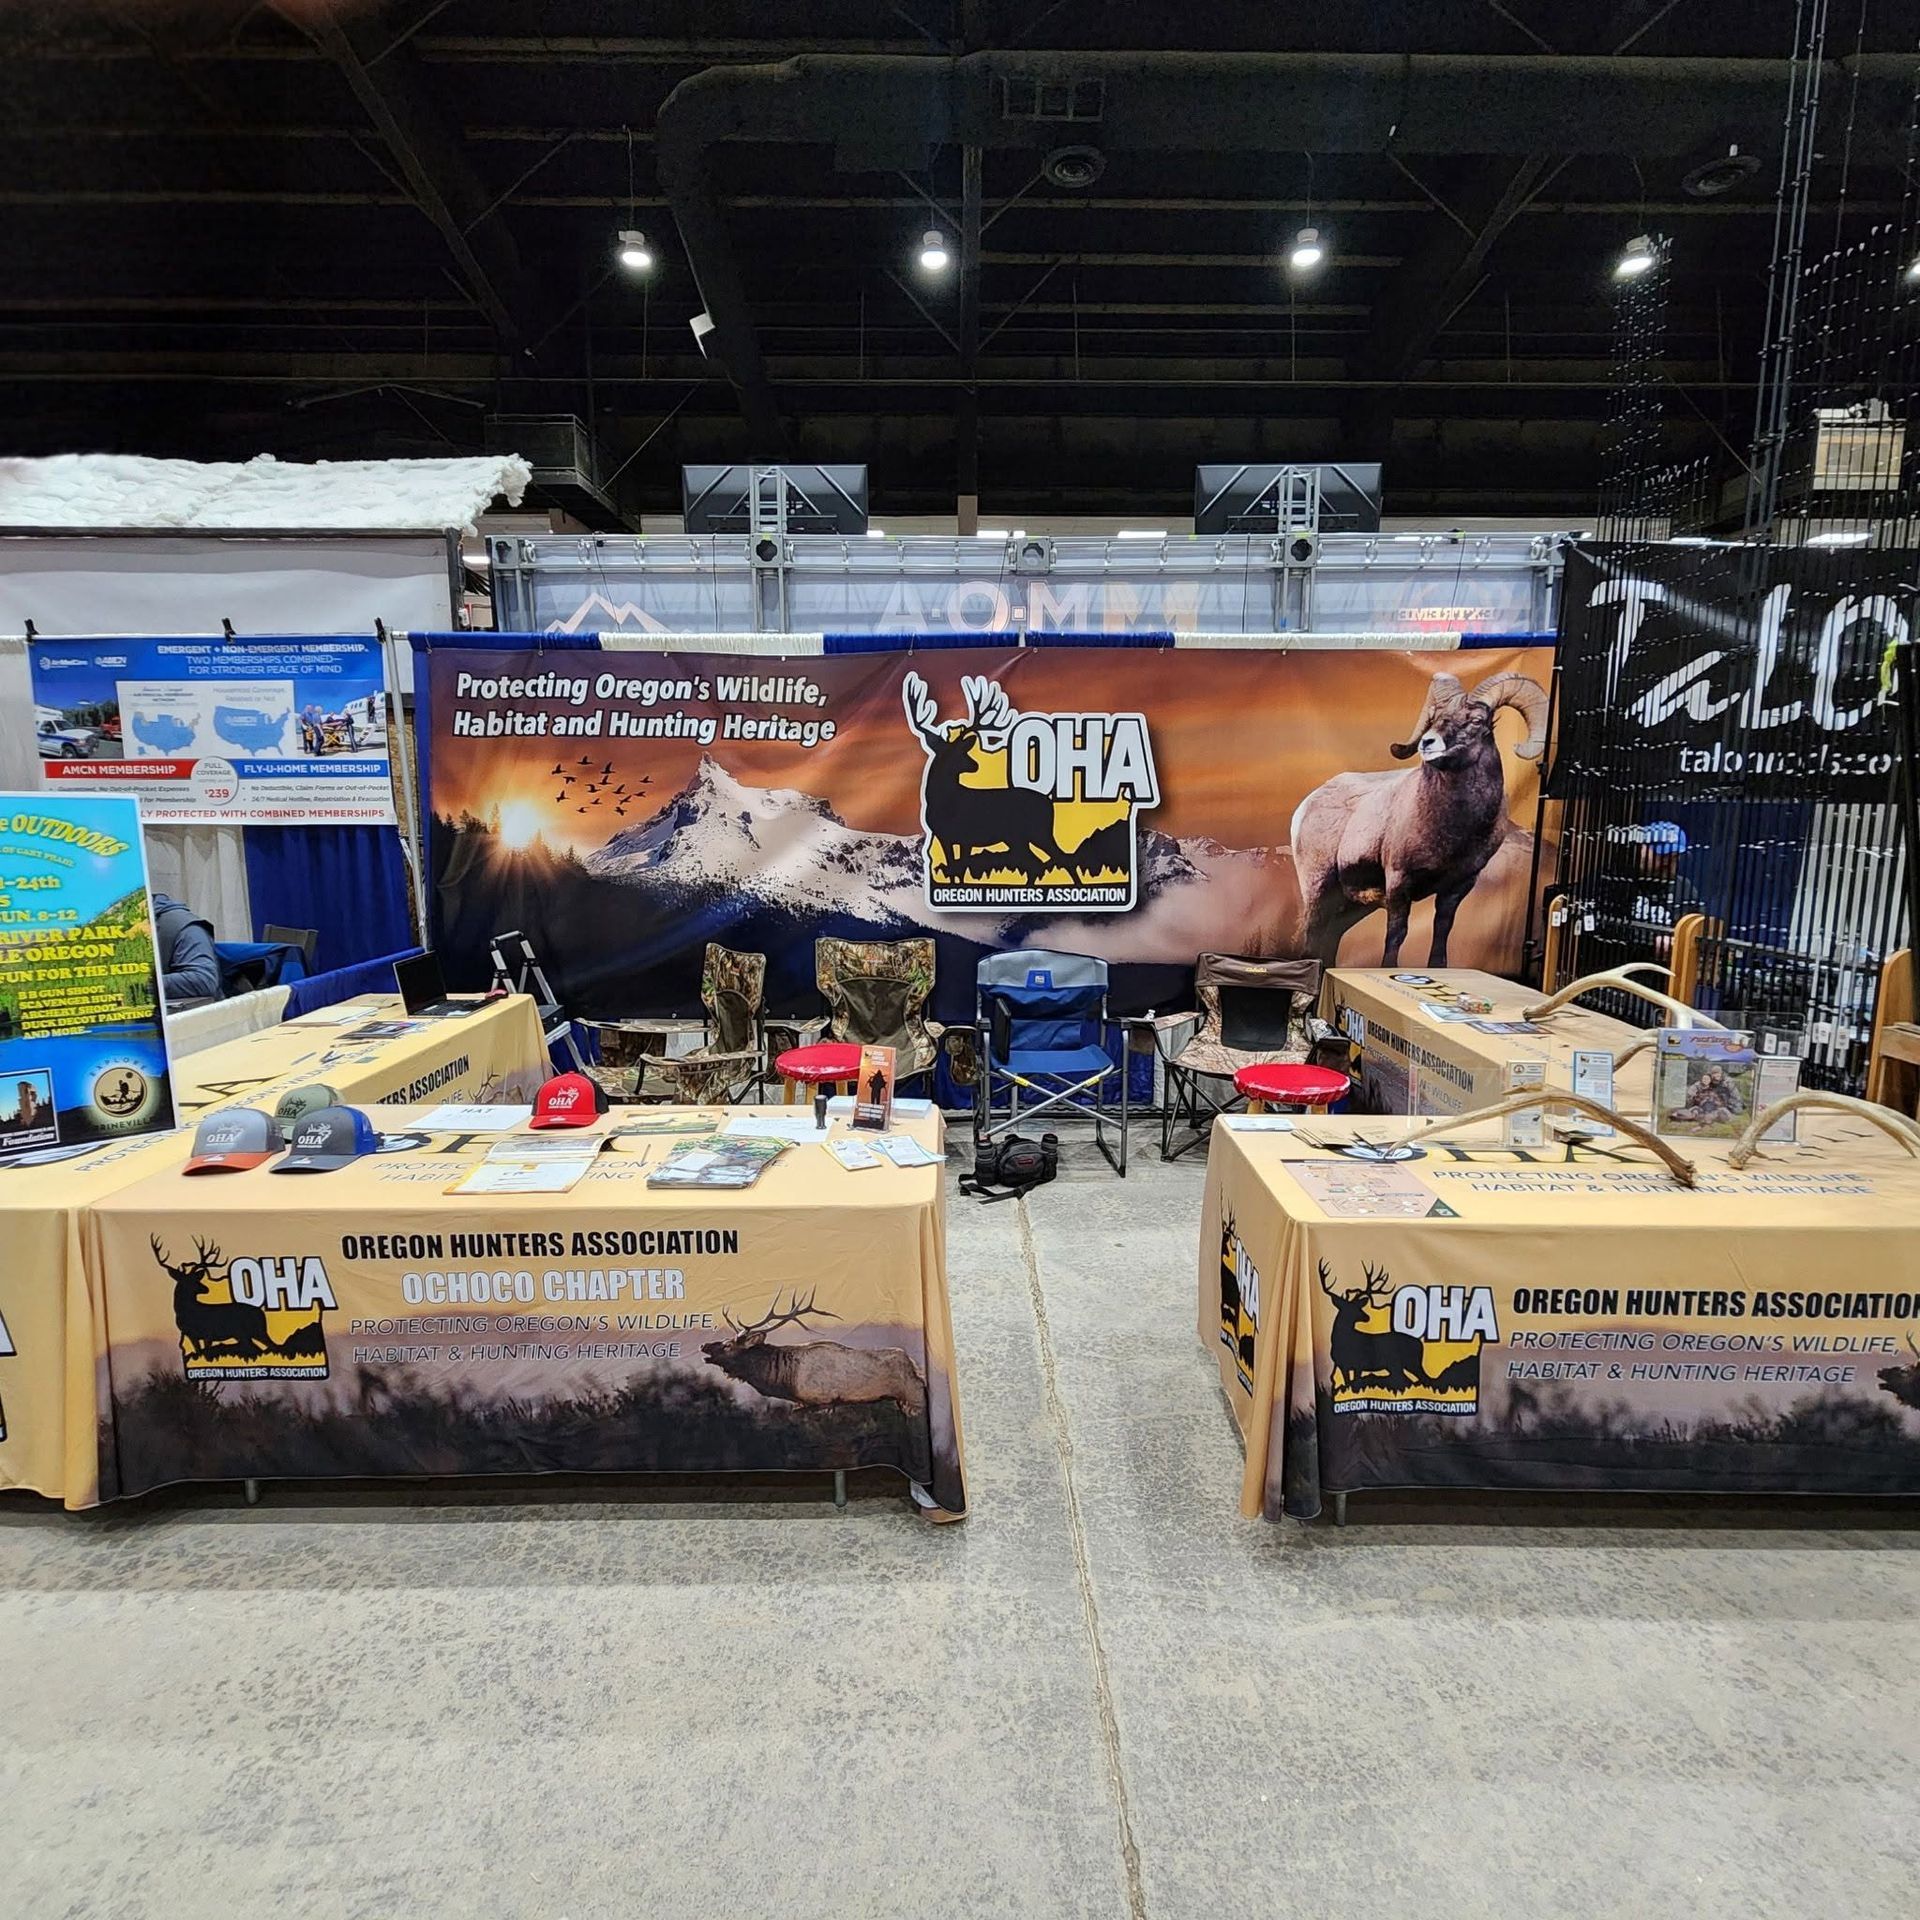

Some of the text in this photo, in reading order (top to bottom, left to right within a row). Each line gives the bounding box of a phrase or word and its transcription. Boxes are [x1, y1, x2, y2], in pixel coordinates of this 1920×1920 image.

[157, 645, 211, 654] EMERGENT
[222, 645, 299, 654] NON-EMERGENT
[187, 655, 210, 665] TWO
[212, 655, 281, 665] MEMBERSHIPS
[188, 664, 342, 675] FOR STRONGER PEACE OF MIND
[456, 671, 829, 709] Protecting Oregon's Wildlife,
[452, 710, 837, 748] Habitat and Hunting Heritage
[1011, 716, 1153, 796] OHA
[62, 765, 177, 775] AMCN MEMBERSHIP
[244, 764, 381, 773] FLY-U-HOME MEMBERSHIP
[204, 788, 229, 798] $239
[156, 810, 217, 818] PROTECTED
[221, 809, 247, 818] WITH
[251, 809, 305, 818] COMBINED
[308, 809, 385, 818] MEMBERSHIPS
[11, 813, 130, 857] OUTDOORS
[933, 888, 1125, 902] OREGON HUNTERS ASSOCIATION
[67, 925, 128, 941] PARK
[25, 943, 116, 962] OREGON
[36, 968, 73, 981] FOR
[73, 965, 109, 978] THE
[110, 962, 151, 976] KIDS
[39, 988, 65, 998] GUN
[66, 985, 106, 995] SHOOT
[19, 993, 125, 1010] SCAVENGER HUNT
[21, 1003, 117, 1020] ARCHERY SHOOT
[21, 1010, 154, 1031] DUCK DECOY PAINTING
[1345, 1006, 1366, 1049] OHA
[22, 1029, 51, 1040] AND
[1367, 1019, 1391, 1047] OREGON
[1391, 1032, 1421, 1064] HUNTERS
[1421, 1048, 1474, 1094] ASSOCIATION
[408, 1053, 469, 1104] ASSOCIATION
[548, 1097, 572, 1106] OHA
[278, 1107, 299, 1117] OHA
[2, 1132, 55, 1147] Foundation
[206, 1133, 235, 1143] OHA
[297, 1135, 324, 1144] OHA
[1433, 1171, 1594, 1181] PROTECTING
[1743, 1172, 1873, 1183] WILDLIFE,
[1472, 1183, 1577, 1192] HABITAT
[1587, 1184, 1604, 1192] &
[1744, 1185, 1876, 1195] HERITAGE
[342, 1230, 739, 1259] OREGON HUNTERS ASSOCIATION
[228, 1256, 339, 1311] OHA
[401, 1268, 686, 1304] OCHOCO CHAPTER
[1236, 1236, 1260, 1334] OHA
[1513, 1287, 1619, 1315] OREGON
[1625, 1289, 1746, 1317] HUNTERS
[1393, 1284, 1499, 1343] OHA
[350, 1313, 719, 1335] PROTECTING OREGON'S WILDLIFE,
[1509, 1331, 1899, 1356] PROTECTING OREGON'S WILDLIFE,
[353, 1342, 681, 1363] HABITAT & HUNTING HERITAGE
[188, 1366, 327, 1379] OREGON HUNTERS ASSOCIATION
[1507, 1361, 1855, 1382] HABITAT & HUNTING HERITAGE
[1334, 1399, 1477, 1413] OREGON HUNTERS ASSOCIATION
